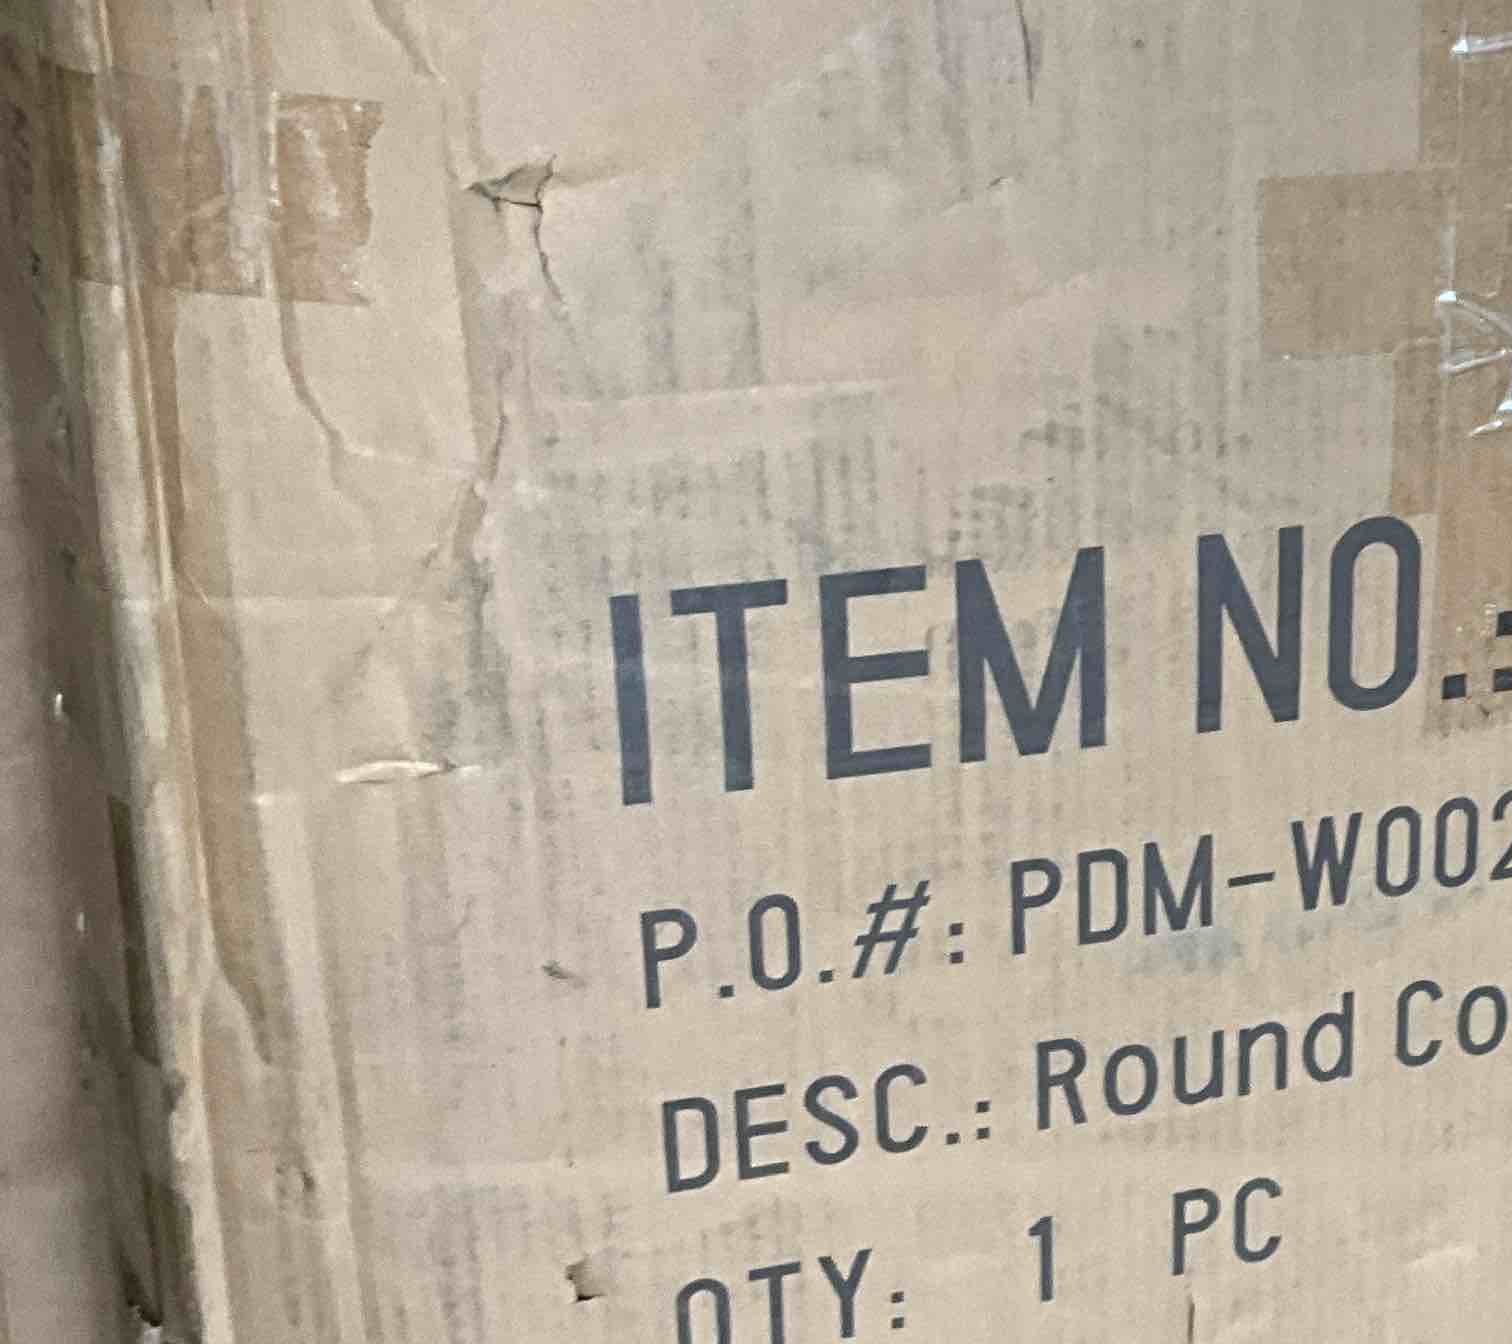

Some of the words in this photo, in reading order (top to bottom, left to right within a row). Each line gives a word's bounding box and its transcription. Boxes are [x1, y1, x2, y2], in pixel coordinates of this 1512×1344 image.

[610, 546, 1107, 805] ITEM
[639, 879, 965, 1009] P.O.#:
[661, 1063, 991, 1194] DESC.:
[1035, 991, 1356, 1130] Round
[1027, 1216, 1054, 1302] 1
[1170, 1177, 1283, 1276] PC
